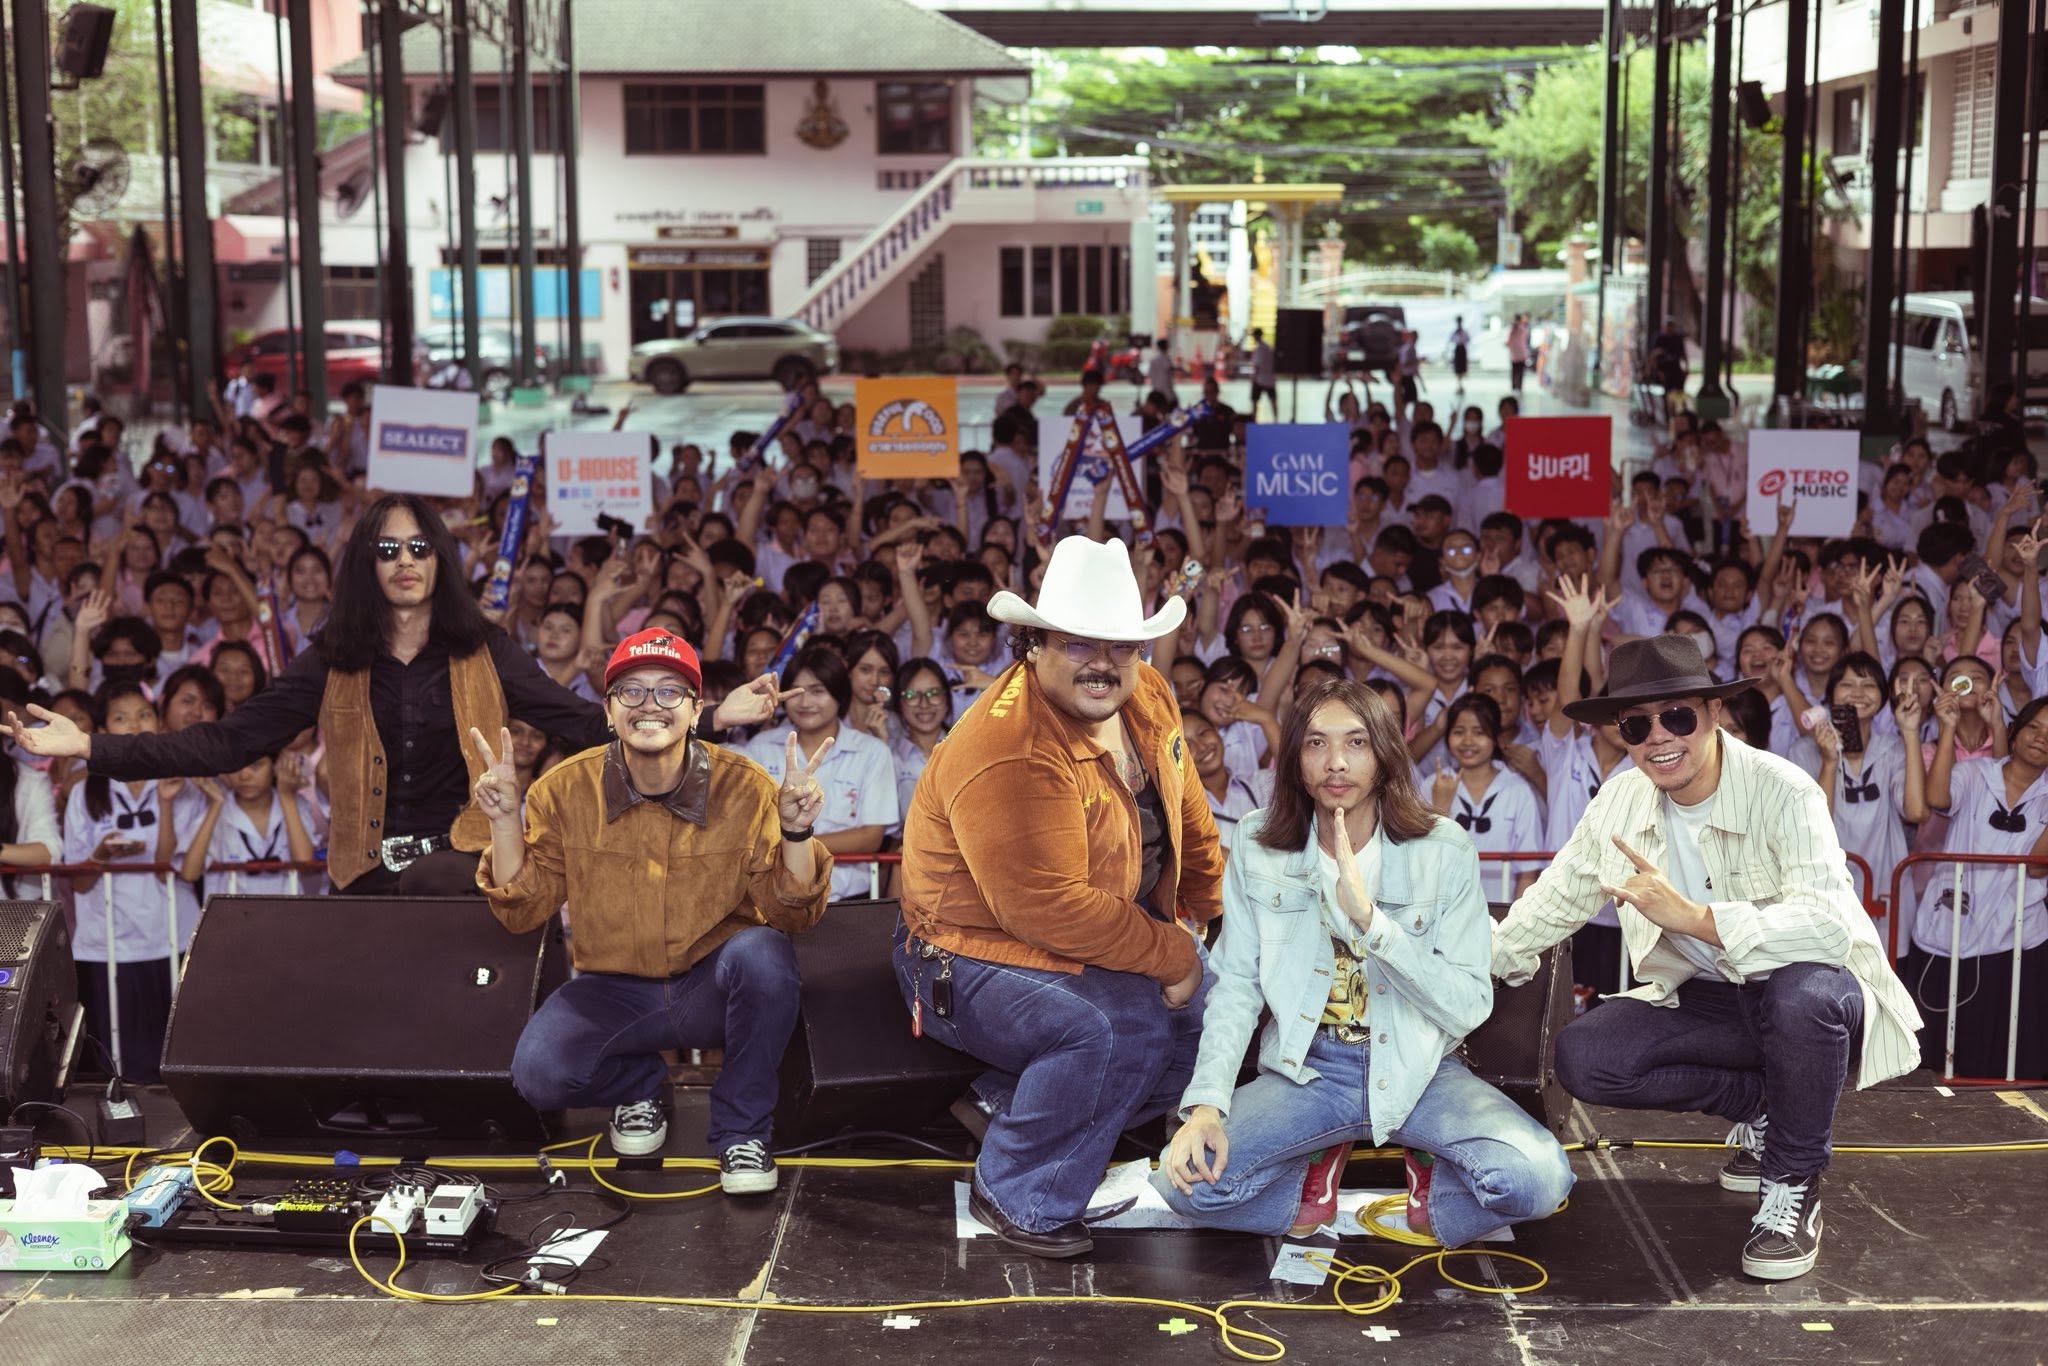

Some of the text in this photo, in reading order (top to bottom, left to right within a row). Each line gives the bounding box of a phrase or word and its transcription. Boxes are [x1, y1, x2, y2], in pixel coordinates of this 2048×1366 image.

[383, 430, 463, 451] SEALECT
[557, 456, 639, 482] U-HOUSE
[1271, 453, 1324, 472] GMM
[1256, 471, 1339, 497] MUSIC
[1788, 469, 1850, 485] TERO
[1792, 485, 1849, 498] MUSIC
[629, 643, 682, 660] Telluride
[20, 1232, 61, 1247] Kleenex
